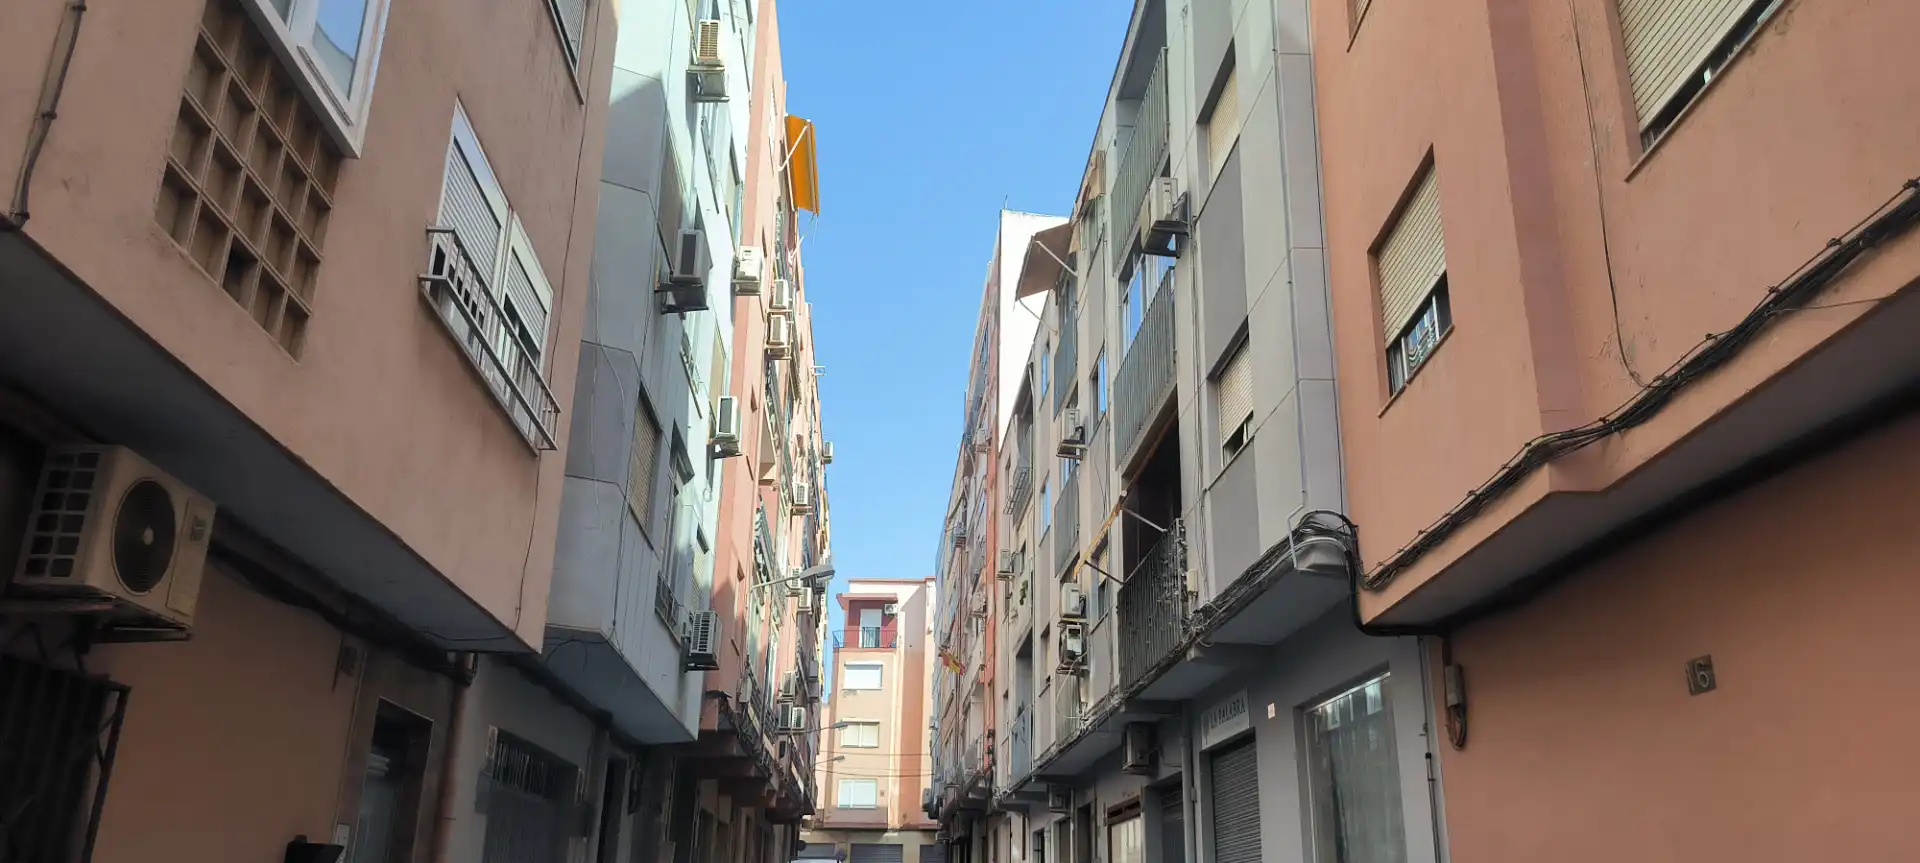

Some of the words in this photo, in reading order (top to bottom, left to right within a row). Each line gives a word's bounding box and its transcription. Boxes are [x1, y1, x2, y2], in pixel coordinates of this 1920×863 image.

[1686, 660, 1710, 692] 16
[1210, 711, 1217, 728] LA
[1218, 697, 1245, 725] PALABRA
